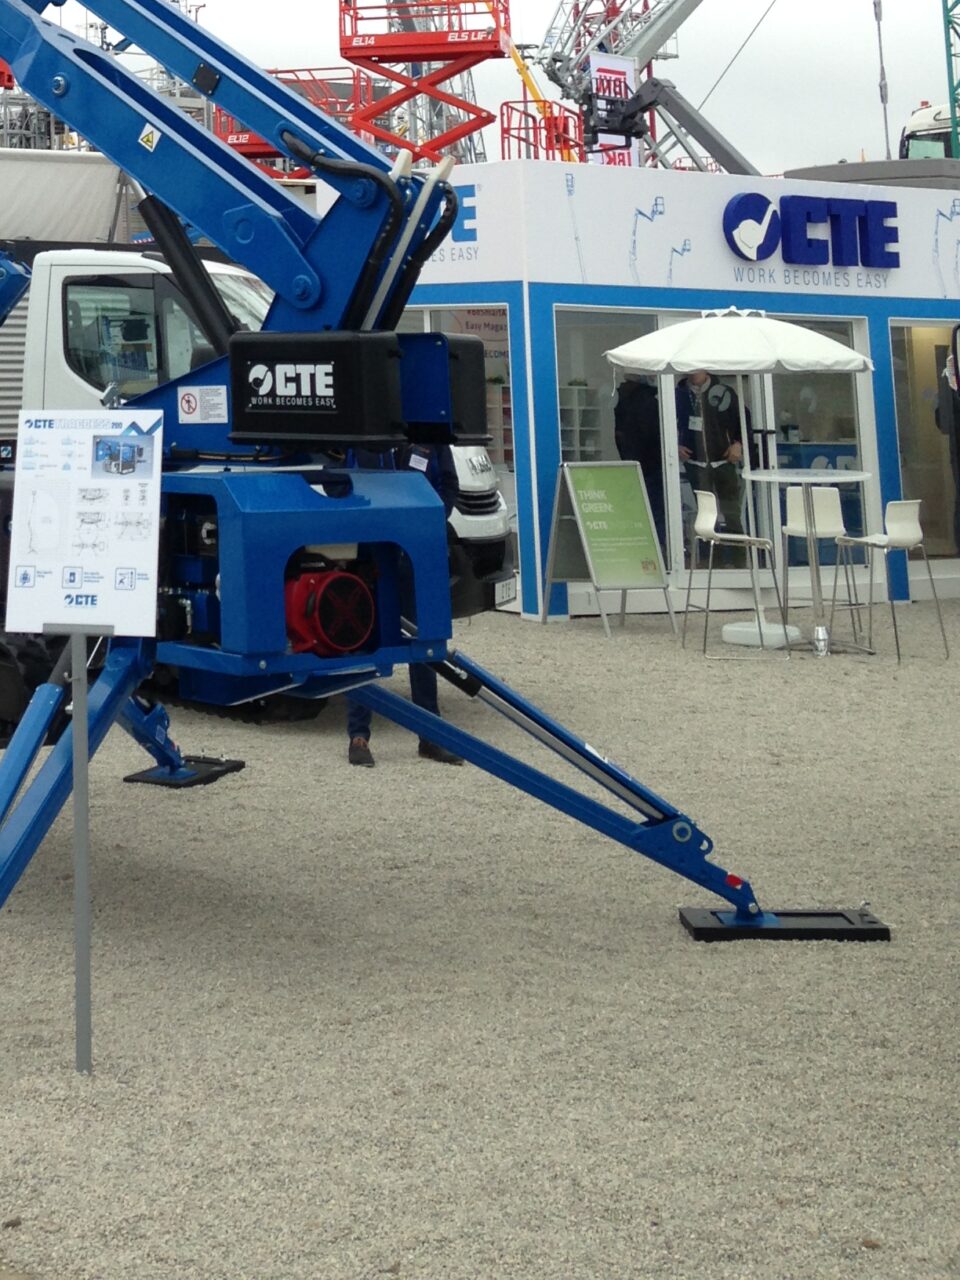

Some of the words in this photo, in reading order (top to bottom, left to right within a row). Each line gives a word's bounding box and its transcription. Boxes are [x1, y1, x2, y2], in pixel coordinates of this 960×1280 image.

[352, 36, 375, 46] EL14
[227, 134, 250, 144] EL12
[779, 194, 901, 269] CTE
[450, 246, 480, 263] EASY
[733, 267, 777, 284] WORK
[784, 269, 851, 288] BECOMES
[856, 272, 889, 289] EASY
[275, 364, 334, 396] CTE
[251, 397, 273, 405] WORK
[276, 397, 313, 406] BECOMES
[315, 397, 335, 407] EASY
[34, 419, 55, 429] CTE
[75, 594, 98, 606] CTE
